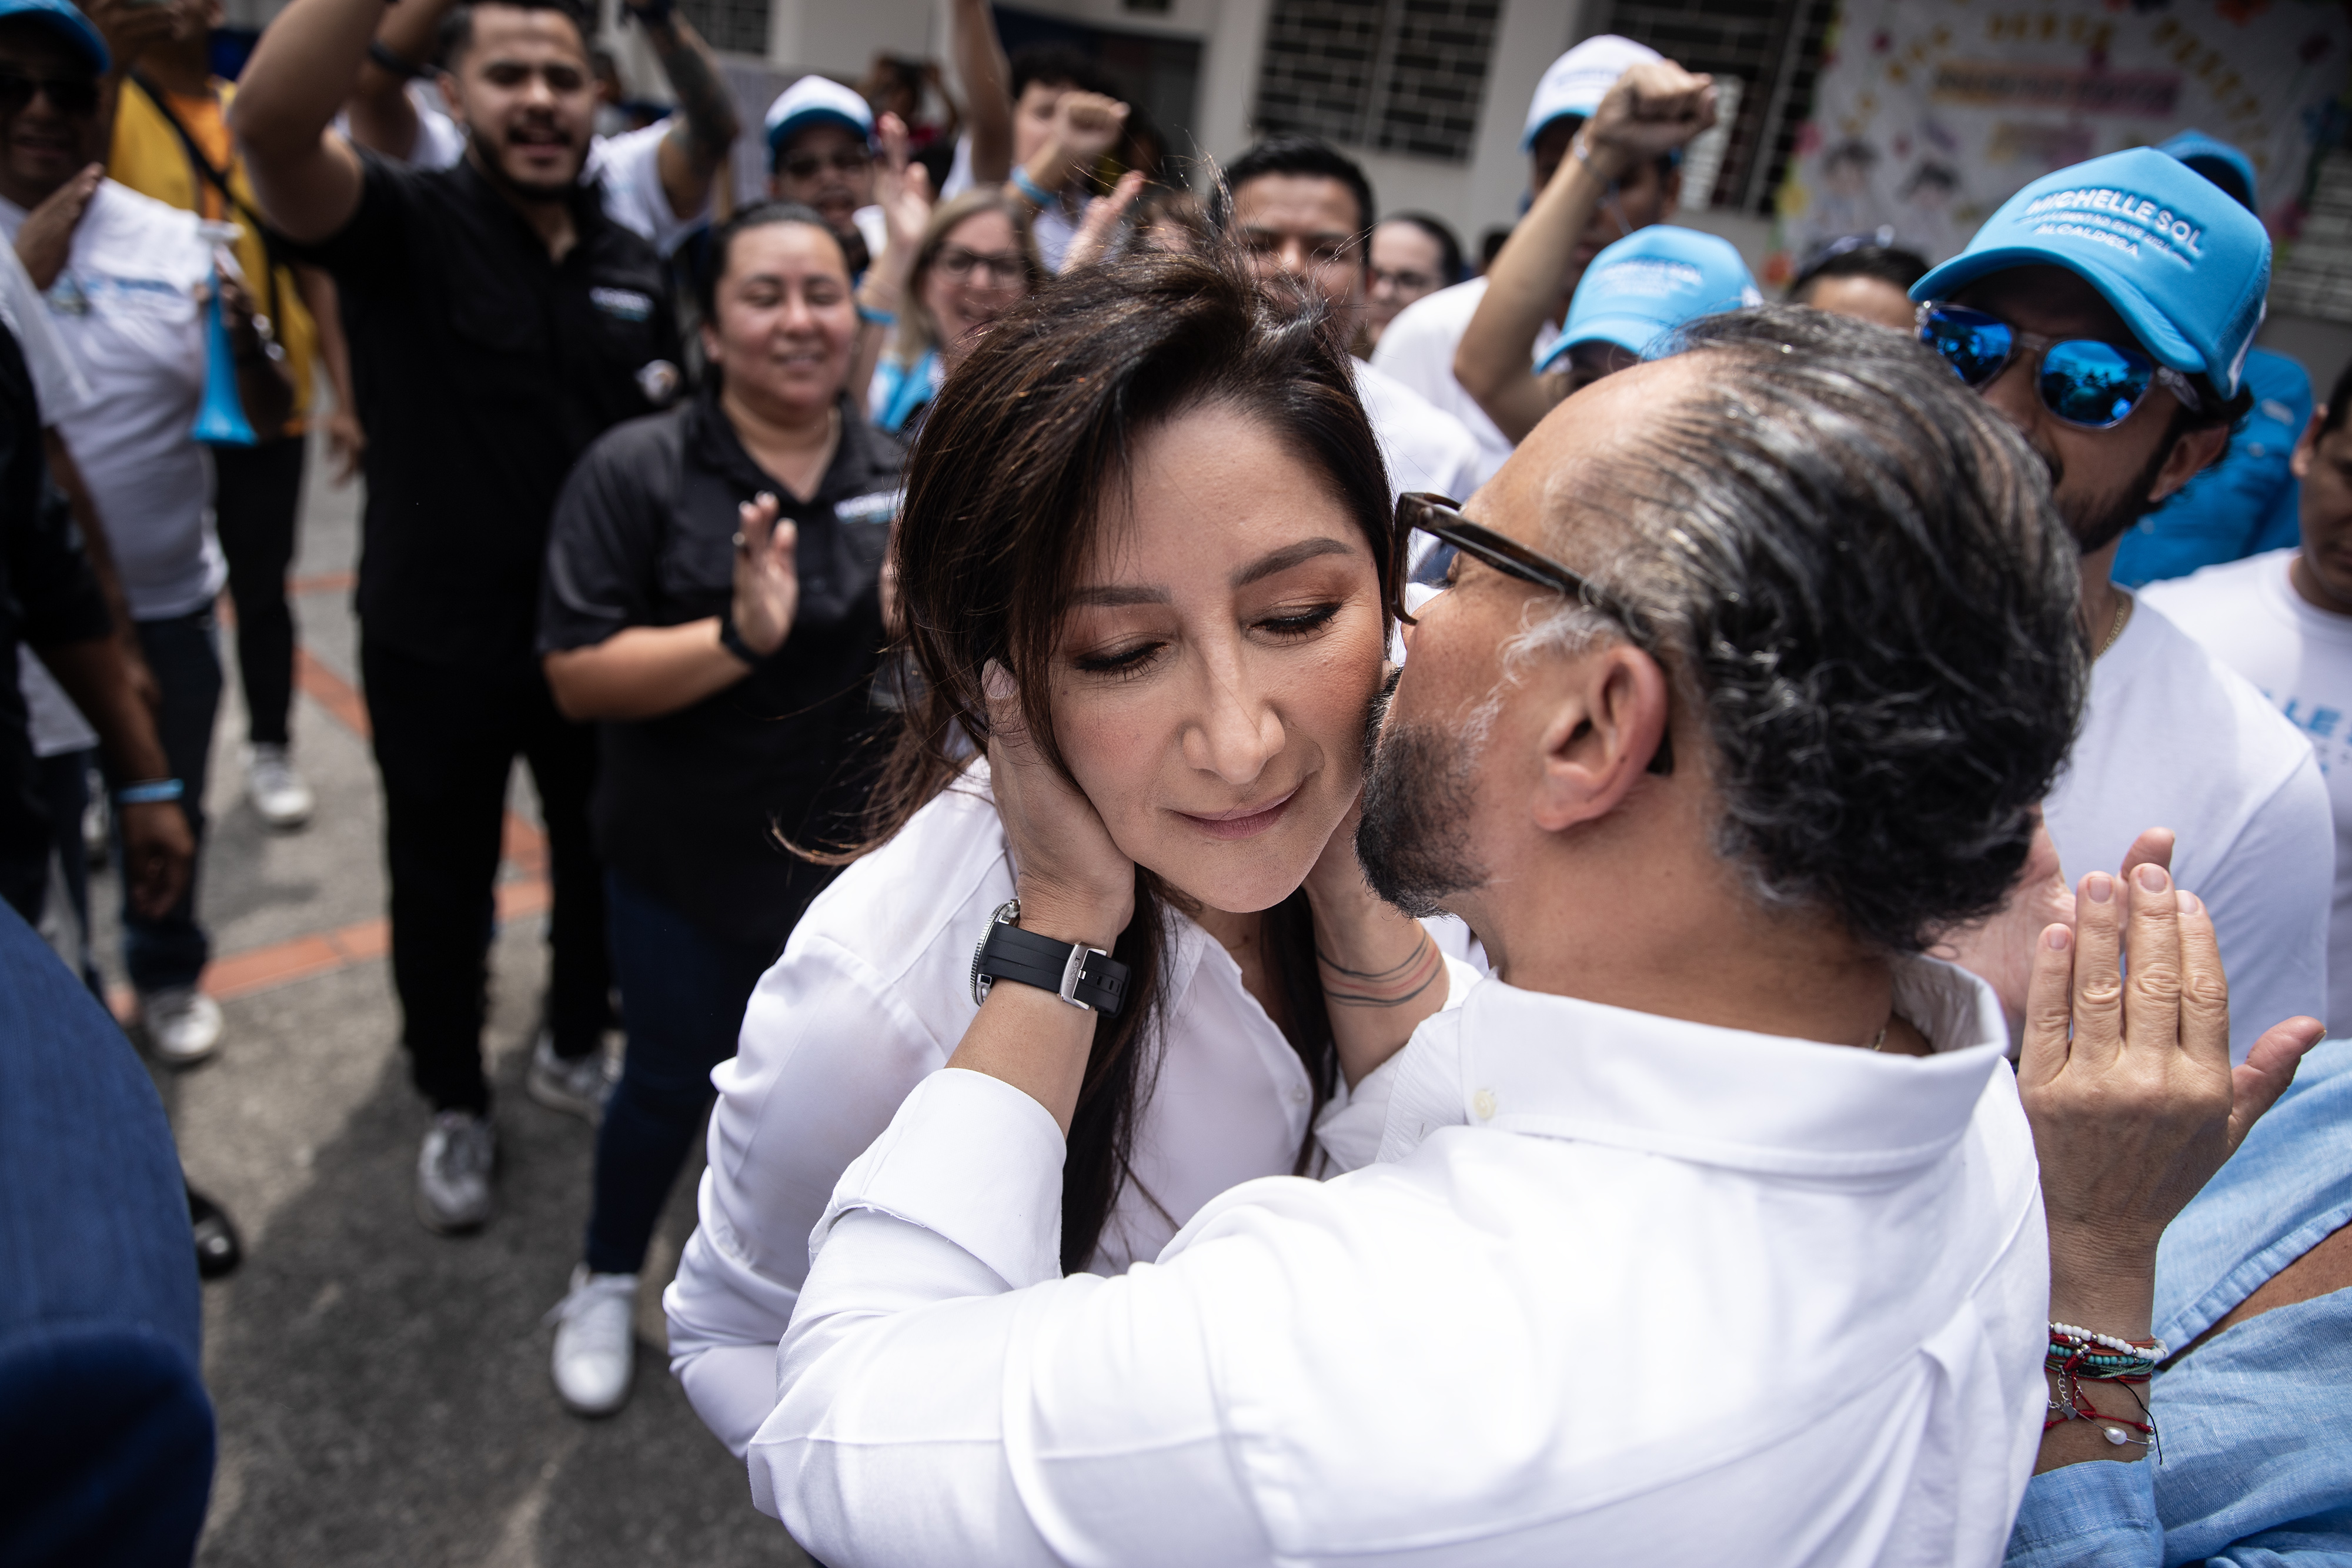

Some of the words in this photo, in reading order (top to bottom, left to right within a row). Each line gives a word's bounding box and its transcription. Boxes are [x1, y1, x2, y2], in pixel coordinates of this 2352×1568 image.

[2024, 188, 2157, 222] MICHELLE
[2154, 209, 2203, 253] SOL
[2033, 223, 2139, 256] ALCALDESA
[1067, 955, 1080, 986] TISSOT
